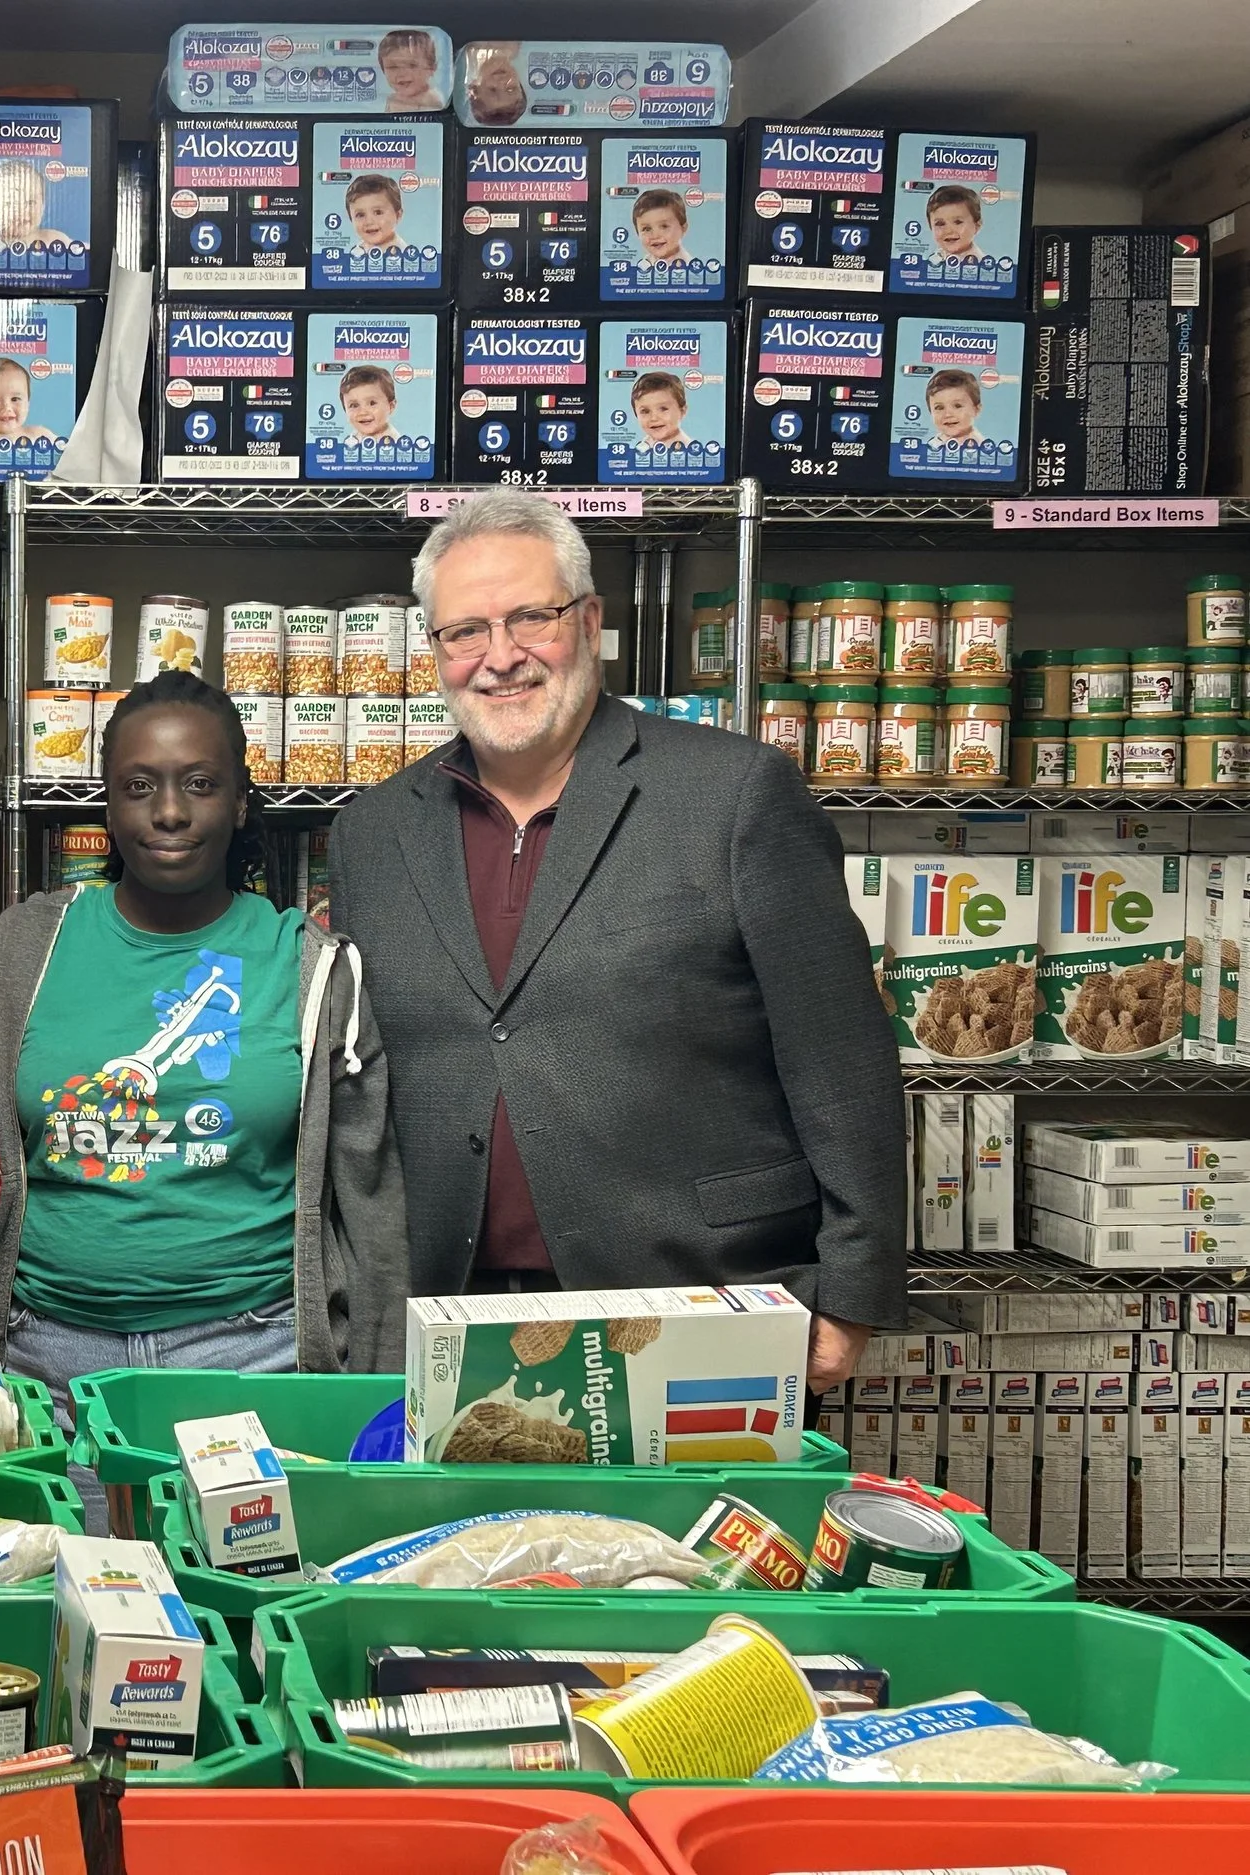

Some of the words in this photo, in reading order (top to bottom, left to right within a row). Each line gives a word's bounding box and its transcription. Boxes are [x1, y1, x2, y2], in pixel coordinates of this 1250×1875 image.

[177, 135, 298, 165] Alokozay
[473, 136, 547, 145] DERMATOLOGIST
[549, 136, 582, 145] TESTED
[764, 138, 883, 172] Alokozay
[469, 150, 587, 180] Alokozay
[776, 170, 810, 181] BABY
[813, 172, 867, 184] DIAPERS
[197, 225, 214, 250] 5
[259, 225, 281, 243] 76
[488, 242, 506, 266] 5
[549, 242, 570, 260] 76
[503, 288, 524, 303] 38
[539, 288, 550, 302] 2
[172, 324, 292, 356] Alokozay
[467, 333, 585, 364] Alokozay
[762, 322, 882, 357] Alokozay
[1033, 326, 1056, 401] Alokozay
[1052, 442, 1066, 452] 6
[1177, 426, 1187, 461] Online
[1037, 454, 1049, 488] SIZE
[1052, 469, 1066, 485] 15
[1176, 464, 1186, 489] Shop
[420, 498, 429, 512] 8
[577, 497, 627, 512] Items
[1005, 508, 1015, 522] 9
[1032, 507, 1112, 523] Standard
[1116, 507, 1151, 522] Box
[1156, 506, 1205, 521] Items
[231, 610, 273, 621] GARDEN
[234, 620, 268, 630] PATCH
[48, 711, 74, 723] Corn
[62, 834, 106, 850] PRIMO
[911, 872, 1007, 937] life
[1060, 869, 1154, 935] life
[883, 962, 959, 982] multigrains
[54, 1110, 106, 1122] OTTAWA
[198, 1111, 222, 1127] 45
[107, 1153, 162, 1164] FESTIVAL
[782, 1374, 799, 1430] QUAKER
[238, 1501, 265, 1519] Tasty
[230, 1519, 273, 1540] Rewards
[722, 1517, 799, 1590] PRIMO
[138, 1661, 172, 1678] Tasty
[121, 1684, 175, 1701] Rewards
[863, 1712, 935, 1733] BLANC
[938, 1707, 978, 1720] RIZ
[918, 1717, 978, 1736] LONG
[846, 1725, 916, 1758] GRAIN
